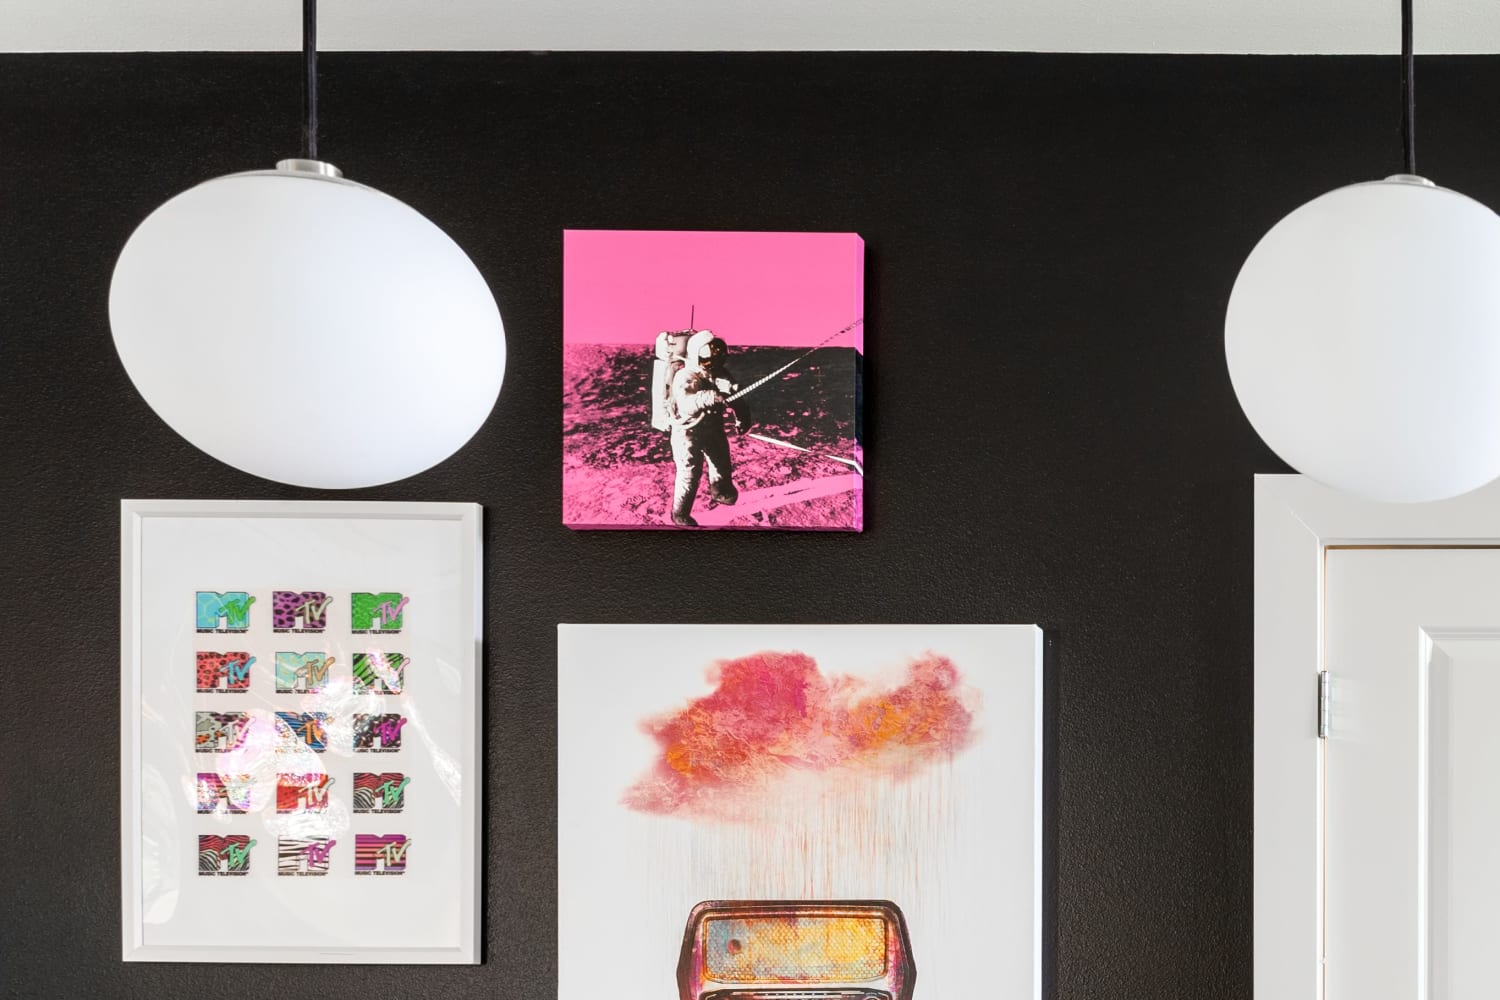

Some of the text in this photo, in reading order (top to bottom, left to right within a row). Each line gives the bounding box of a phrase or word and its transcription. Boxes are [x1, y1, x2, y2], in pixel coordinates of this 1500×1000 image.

[196, 591, 256, 628] MTV
[272, 591, 333, 628] MTV
[351, 592, 409, 629] MTV
[196, 652, 256, 688] MTV
[275, 652, 335, 689] MTV
[353, 773, 410, 809] MTV
[198, 835, 257, 871] MTV
[278, 835, 336, 871] MTV
[354, 834, 411, 870] MTV
